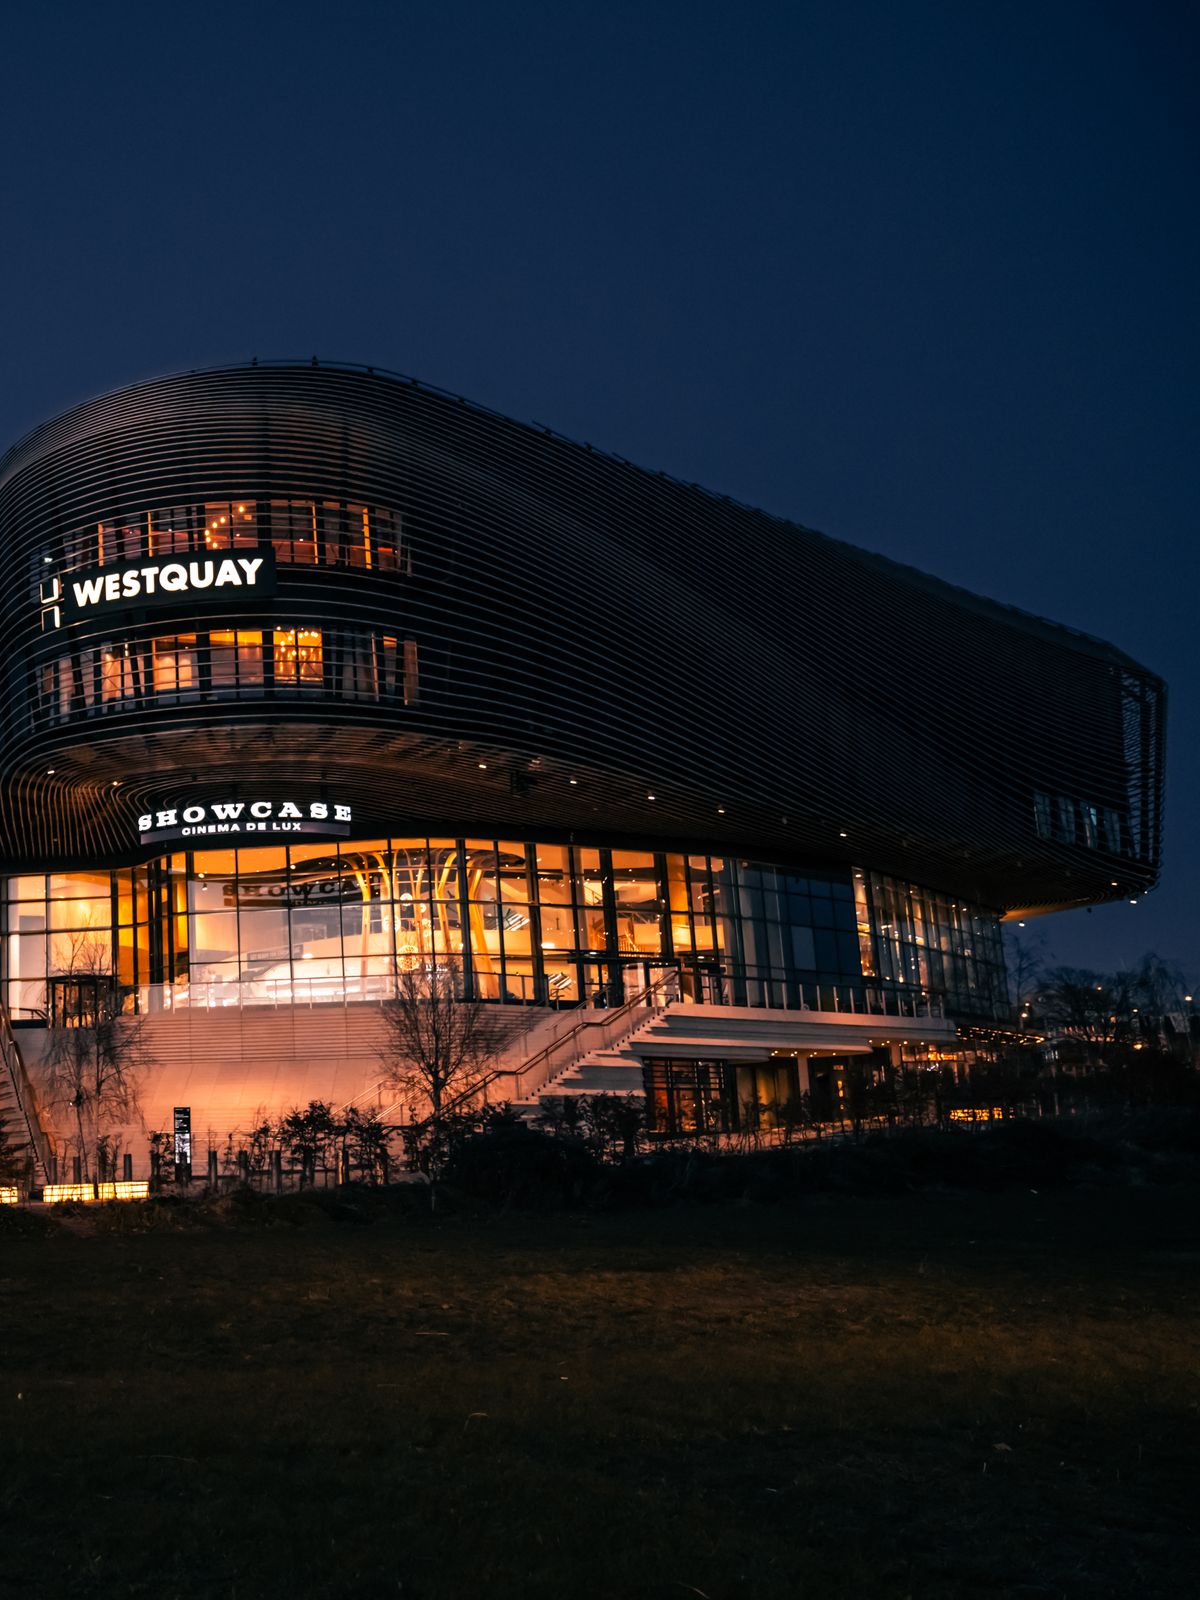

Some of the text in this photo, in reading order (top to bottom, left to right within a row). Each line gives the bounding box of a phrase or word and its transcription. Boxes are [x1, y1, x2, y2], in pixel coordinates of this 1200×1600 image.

[72, 558, 264, 608] WESTQUAY
[137, 801, 352, 832] SHOWCASE
[181, 821, 302, 836] CINEMA DE LUX
